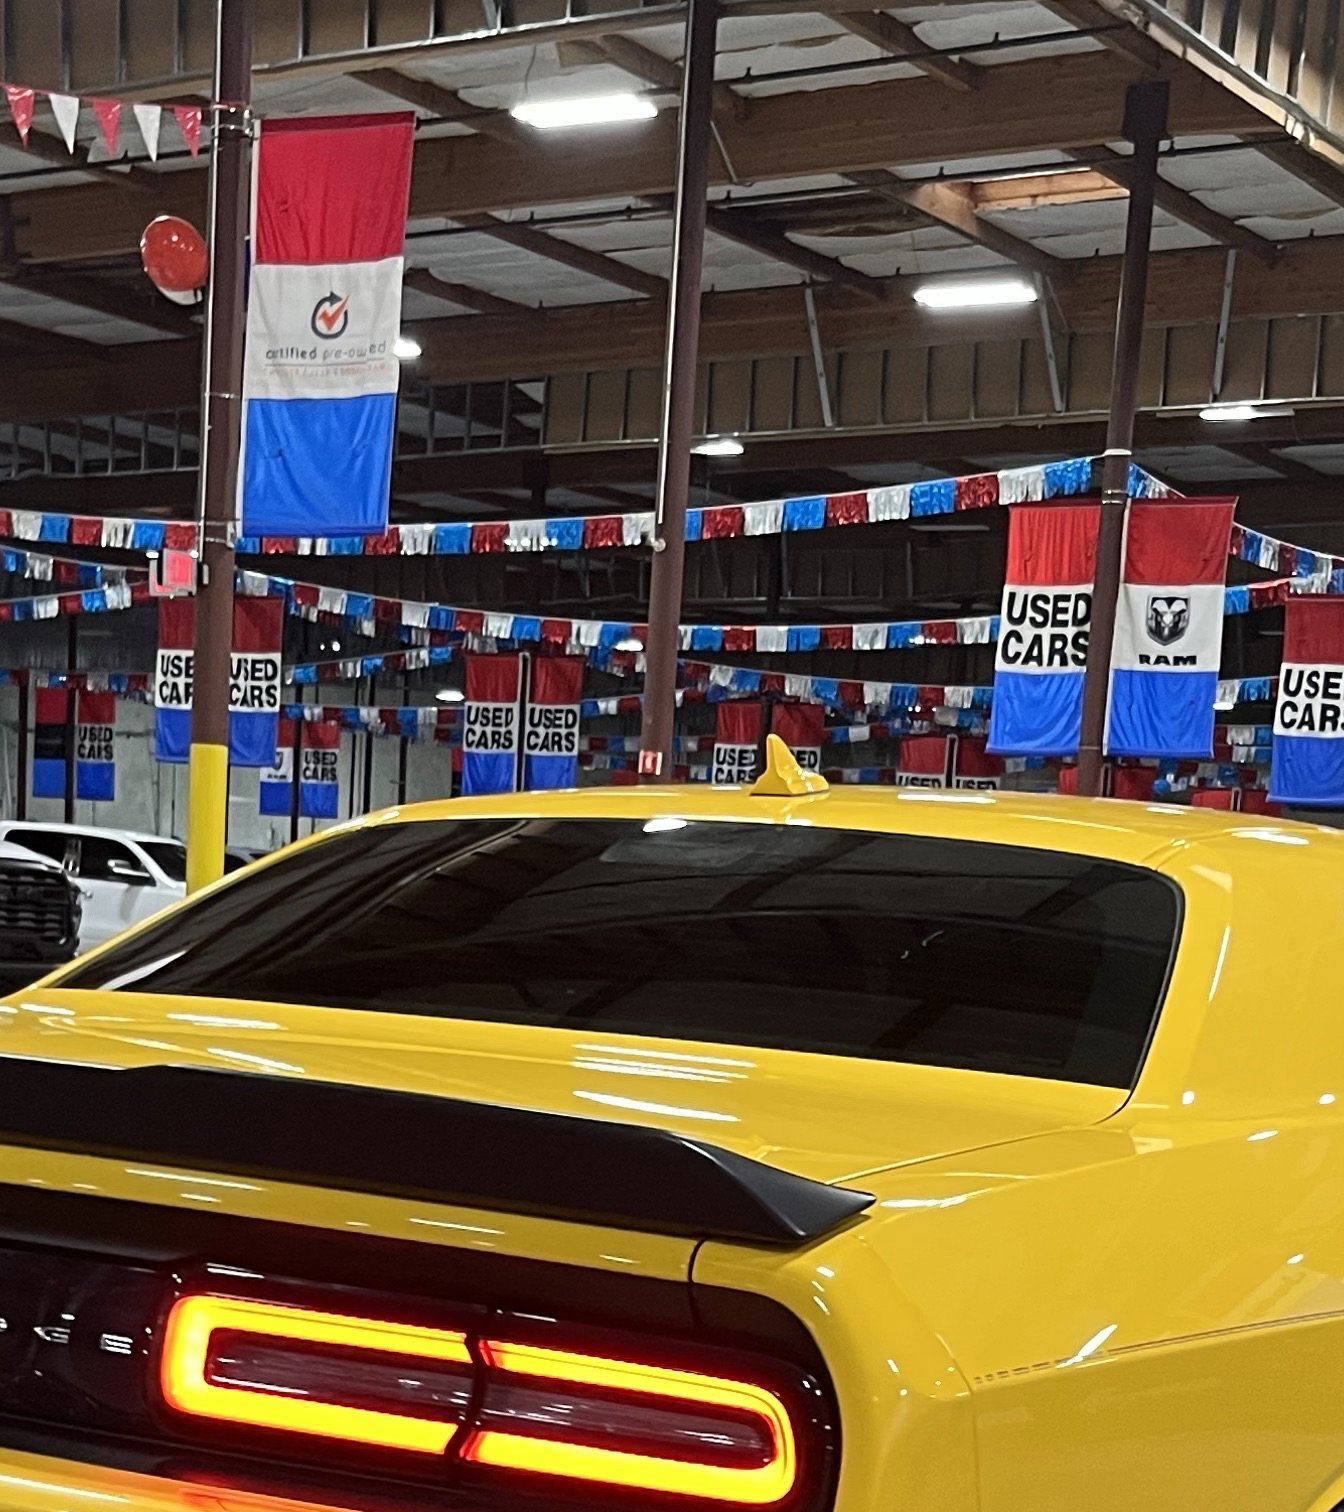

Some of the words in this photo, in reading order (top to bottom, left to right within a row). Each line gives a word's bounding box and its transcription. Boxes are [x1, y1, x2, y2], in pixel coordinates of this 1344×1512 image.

[1006, 591, 1093, 629] USED
[1000, 629, 1090, 667] CARS
[160, 655, 194, 679] USE
[1138, 654, 1197, 666] RAM
[466, 705, 514, 728] USED
[528, 706, 578, 730] USED
[465, 727, 514, 750] CARS
[526, 730, 576, 753] CARS
[304, 750, 338, 766] USED
[303, 766, 338, 781] CARS
